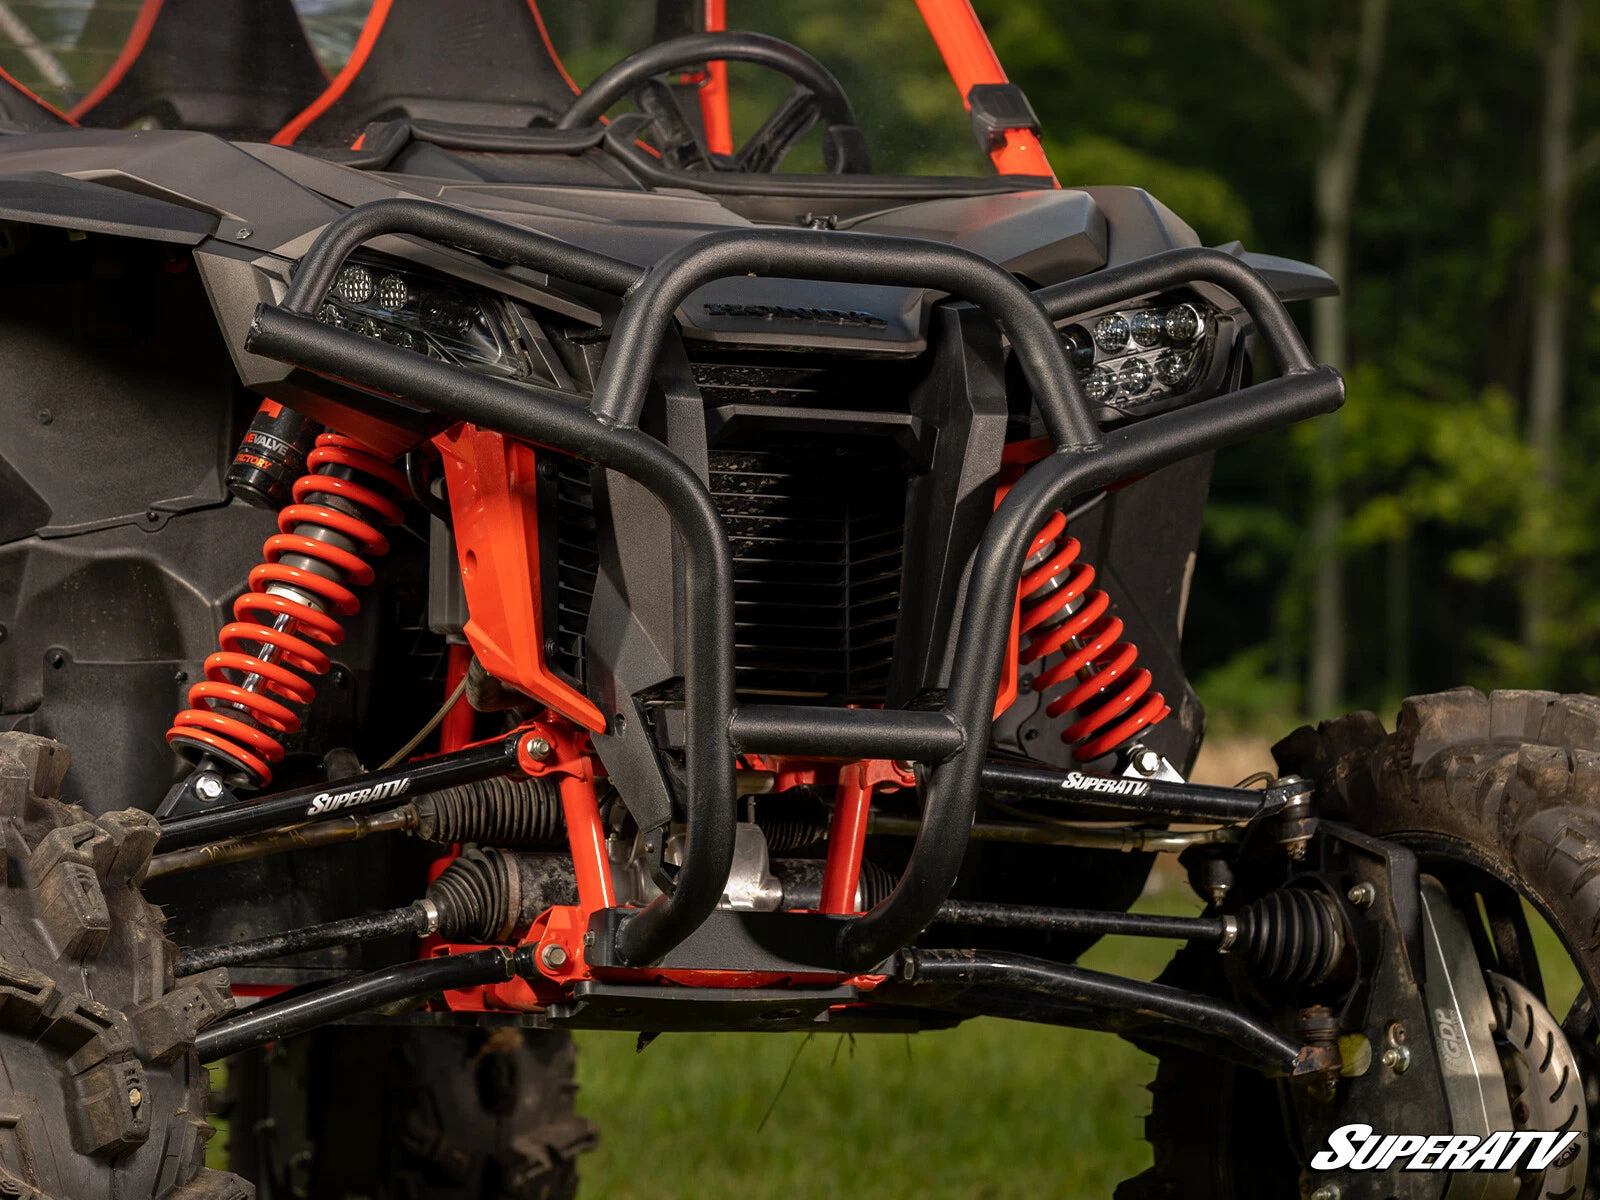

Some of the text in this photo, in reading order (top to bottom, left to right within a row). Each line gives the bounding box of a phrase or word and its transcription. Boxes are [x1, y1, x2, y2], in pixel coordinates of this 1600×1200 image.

[234, 453, 272, 470] CTORY
[307, 778, 409, 816] SUPERATV
[1061, 771, 1147, 796] SUPERATV
[1434, 1008, 1460, 1059] GDP
